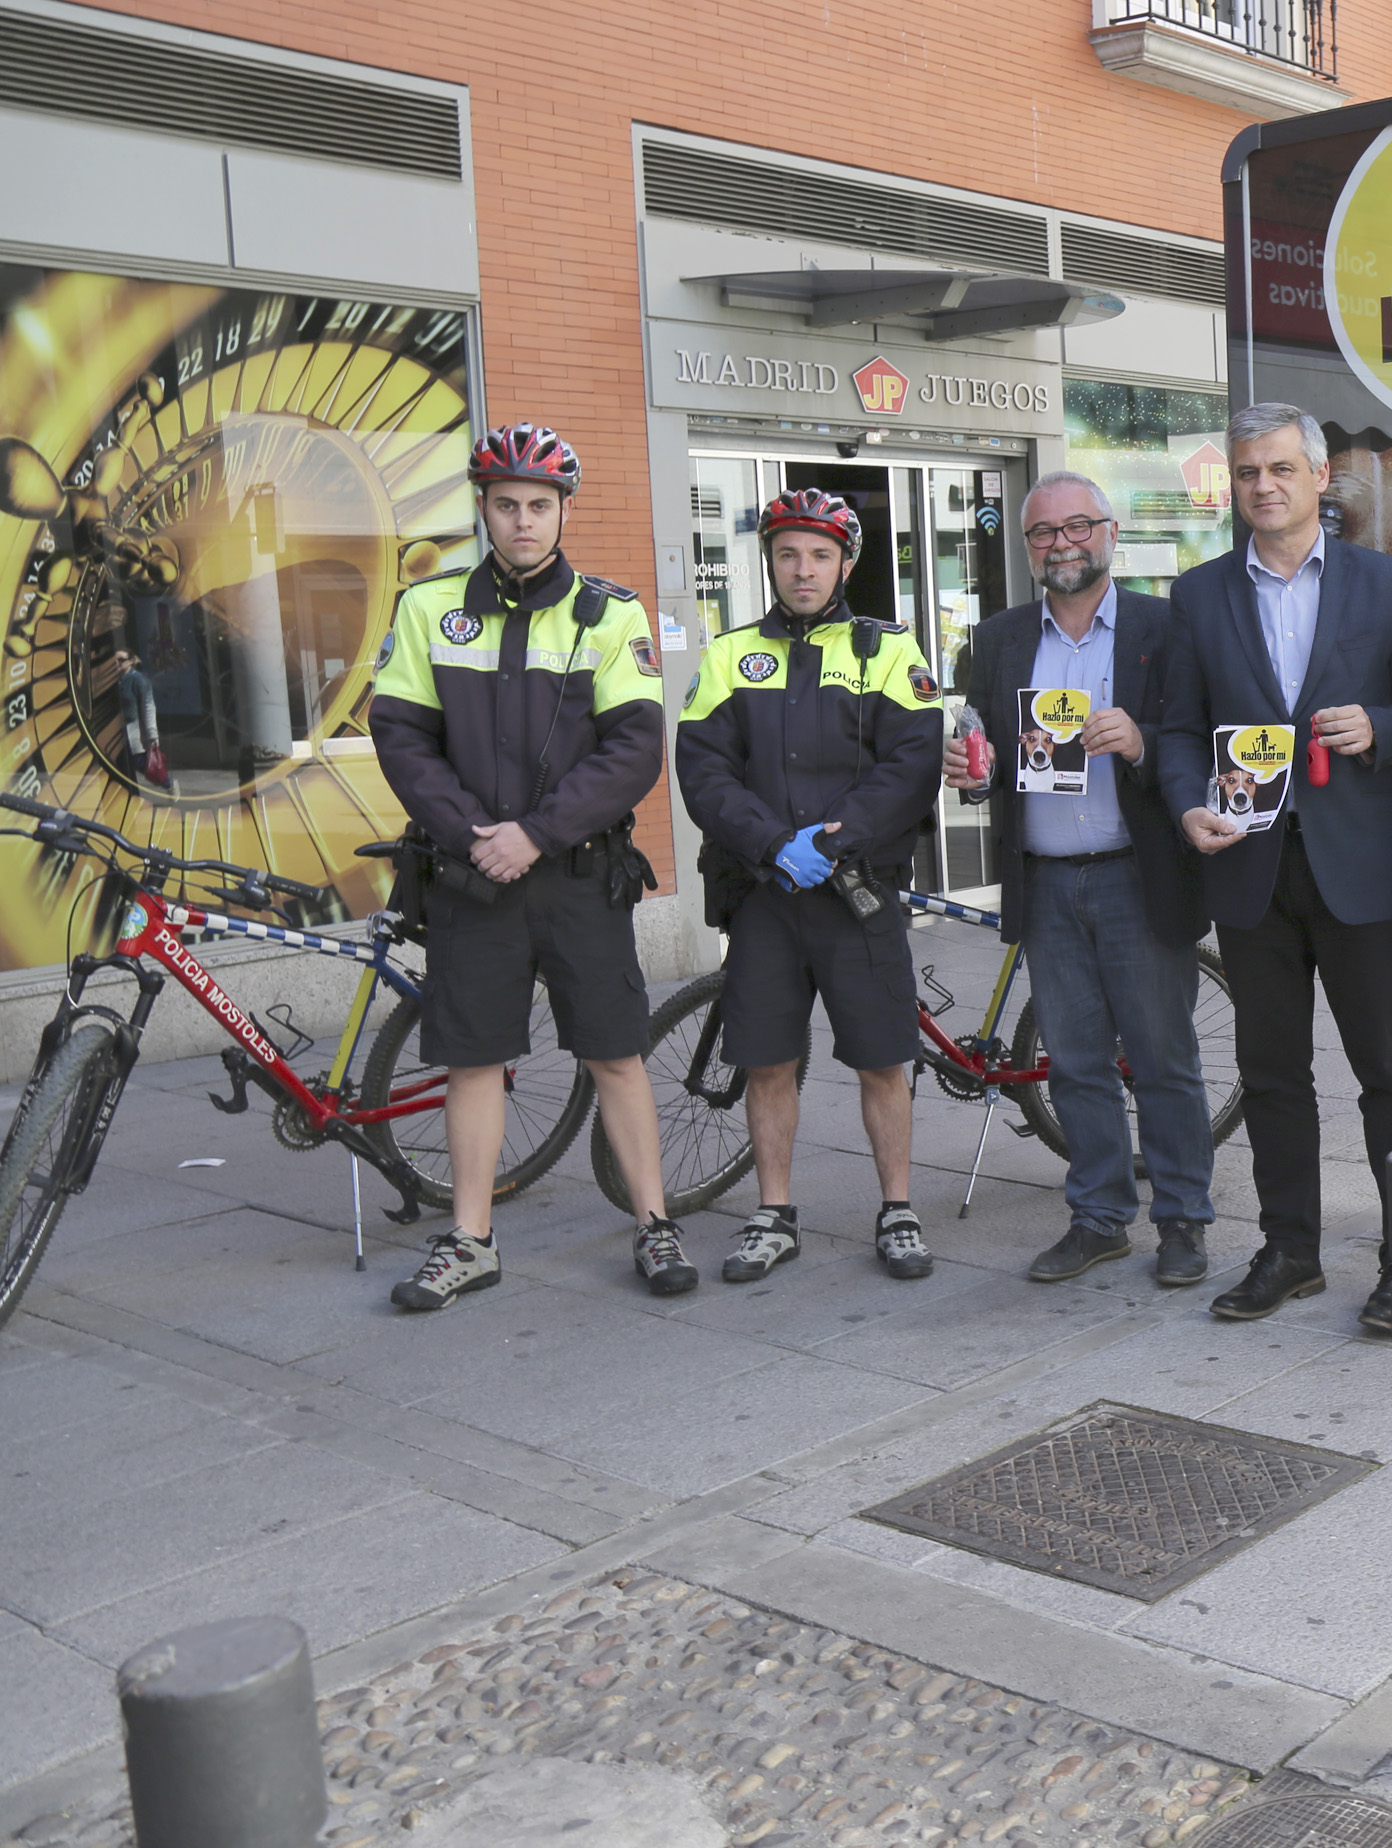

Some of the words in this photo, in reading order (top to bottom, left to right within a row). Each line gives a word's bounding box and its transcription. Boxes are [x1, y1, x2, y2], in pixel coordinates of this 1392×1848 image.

[178, 347, 203, 387] 22
[676, 350, 839, 395] MADRID
[863, 374, 903, 410] JP
[920, 374, 1050, 413] JUEGOS
[1190, 463, 1231, 505] JP
[9, 661, 27, 690] 10
[8, 693, 28, 728] 23
[1062, 713, 1074, 723] por
[1241, 751, 1262, 761] Hazlo
[1263, 752, 1276, 762] por
[154, 929, 209, 992] POLICIA
[206, 986, 277, 1063] MOSTOLES
